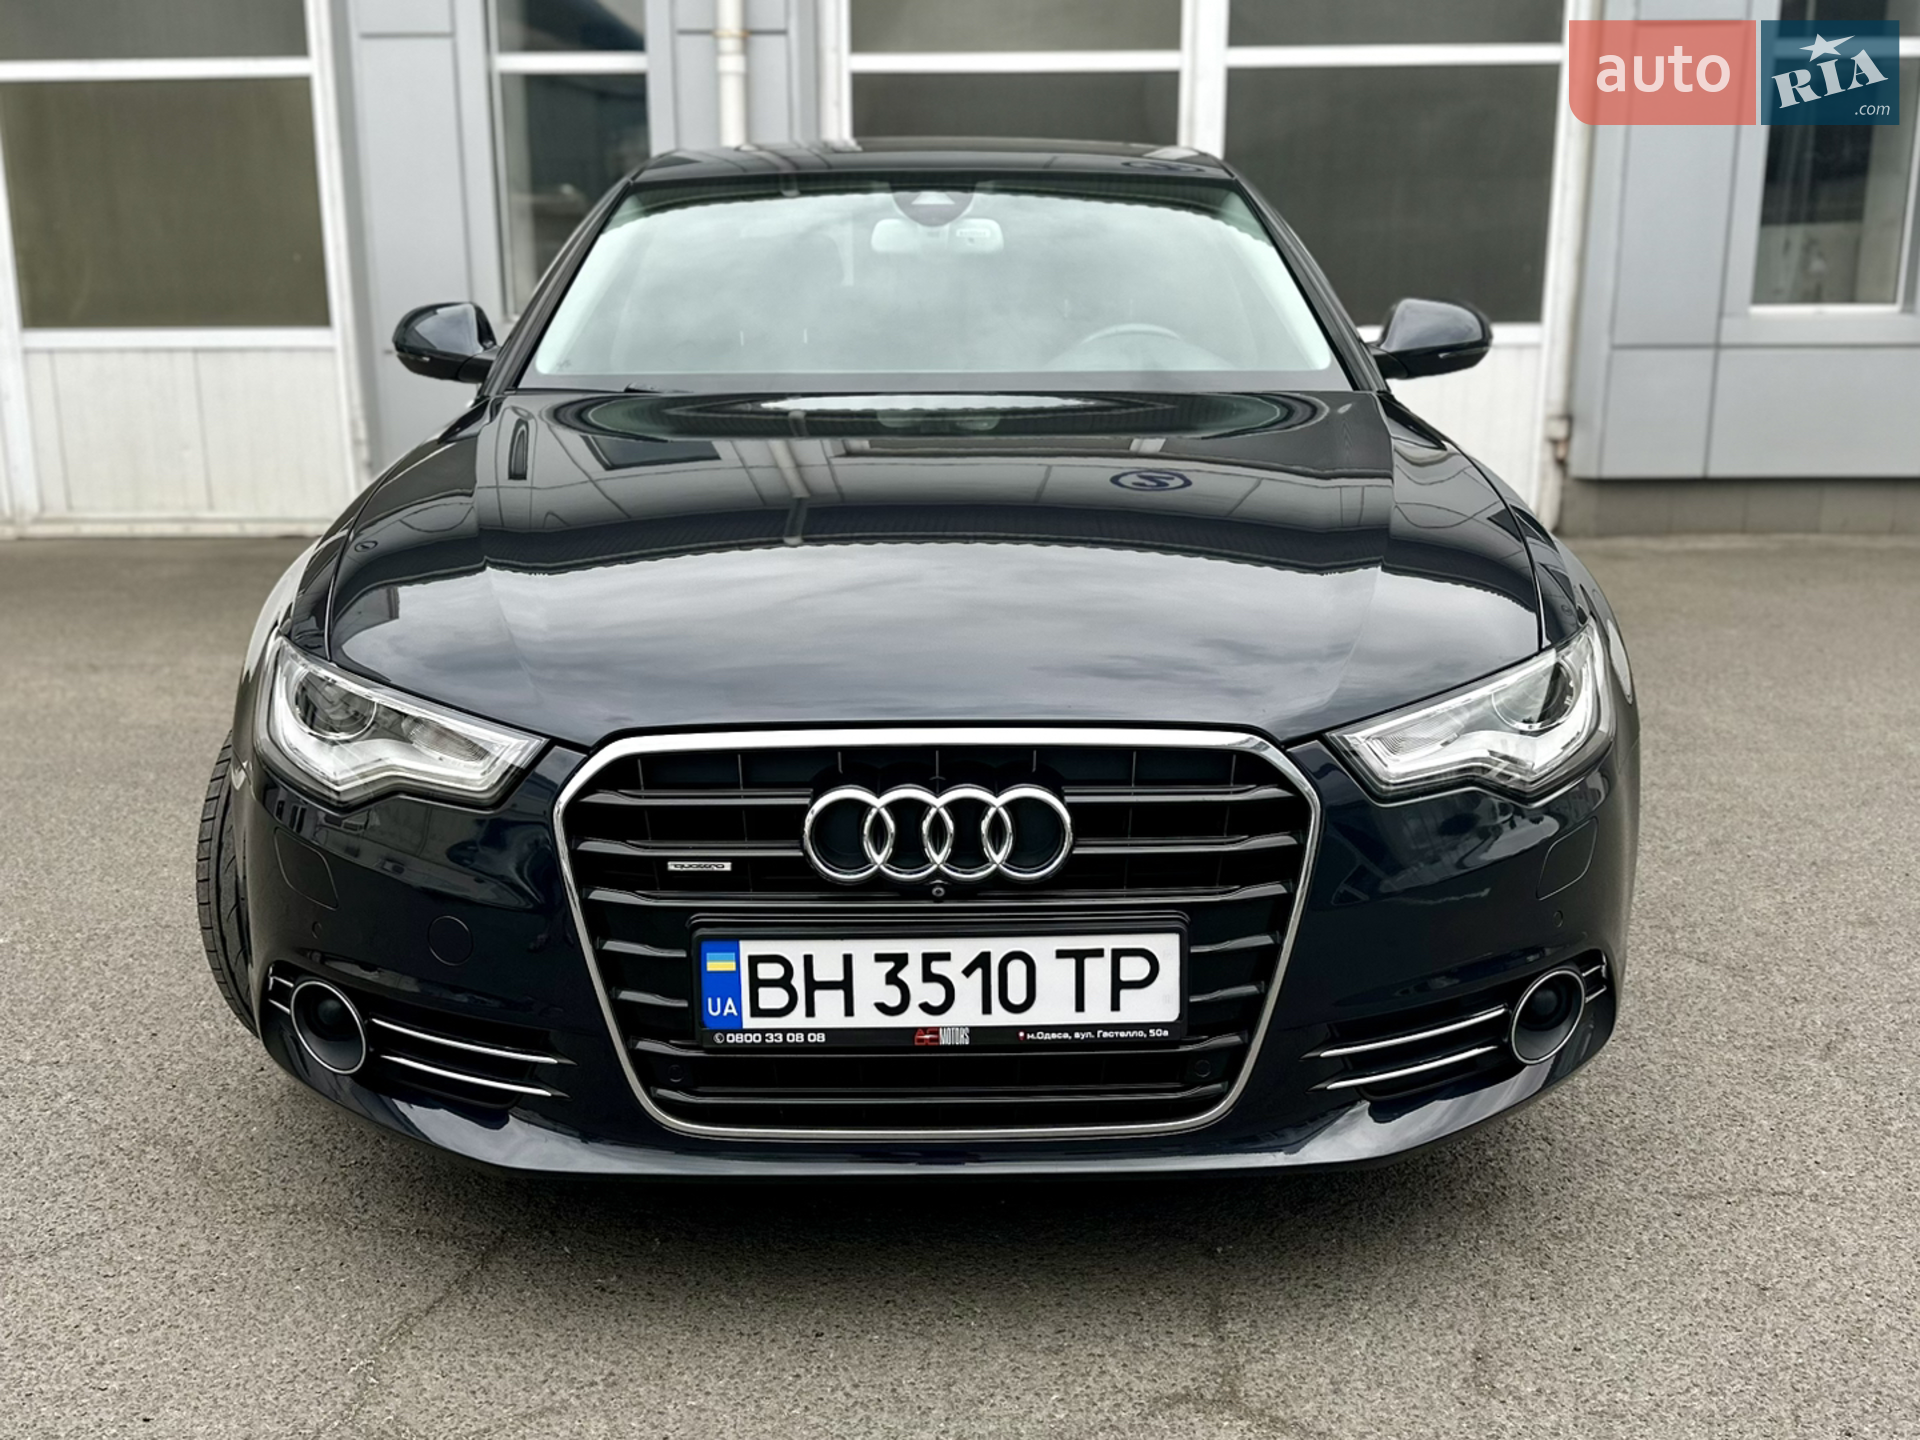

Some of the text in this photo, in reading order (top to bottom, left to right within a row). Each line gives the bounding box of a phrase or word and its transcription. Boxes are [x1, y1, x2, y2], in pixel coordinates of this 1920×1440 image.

[748, 948, 1160, 1018] BH 3510 TP
[707, 997, 738, 1017] UA
[726, 1032, 826, 1044] 0800 33 08 08
